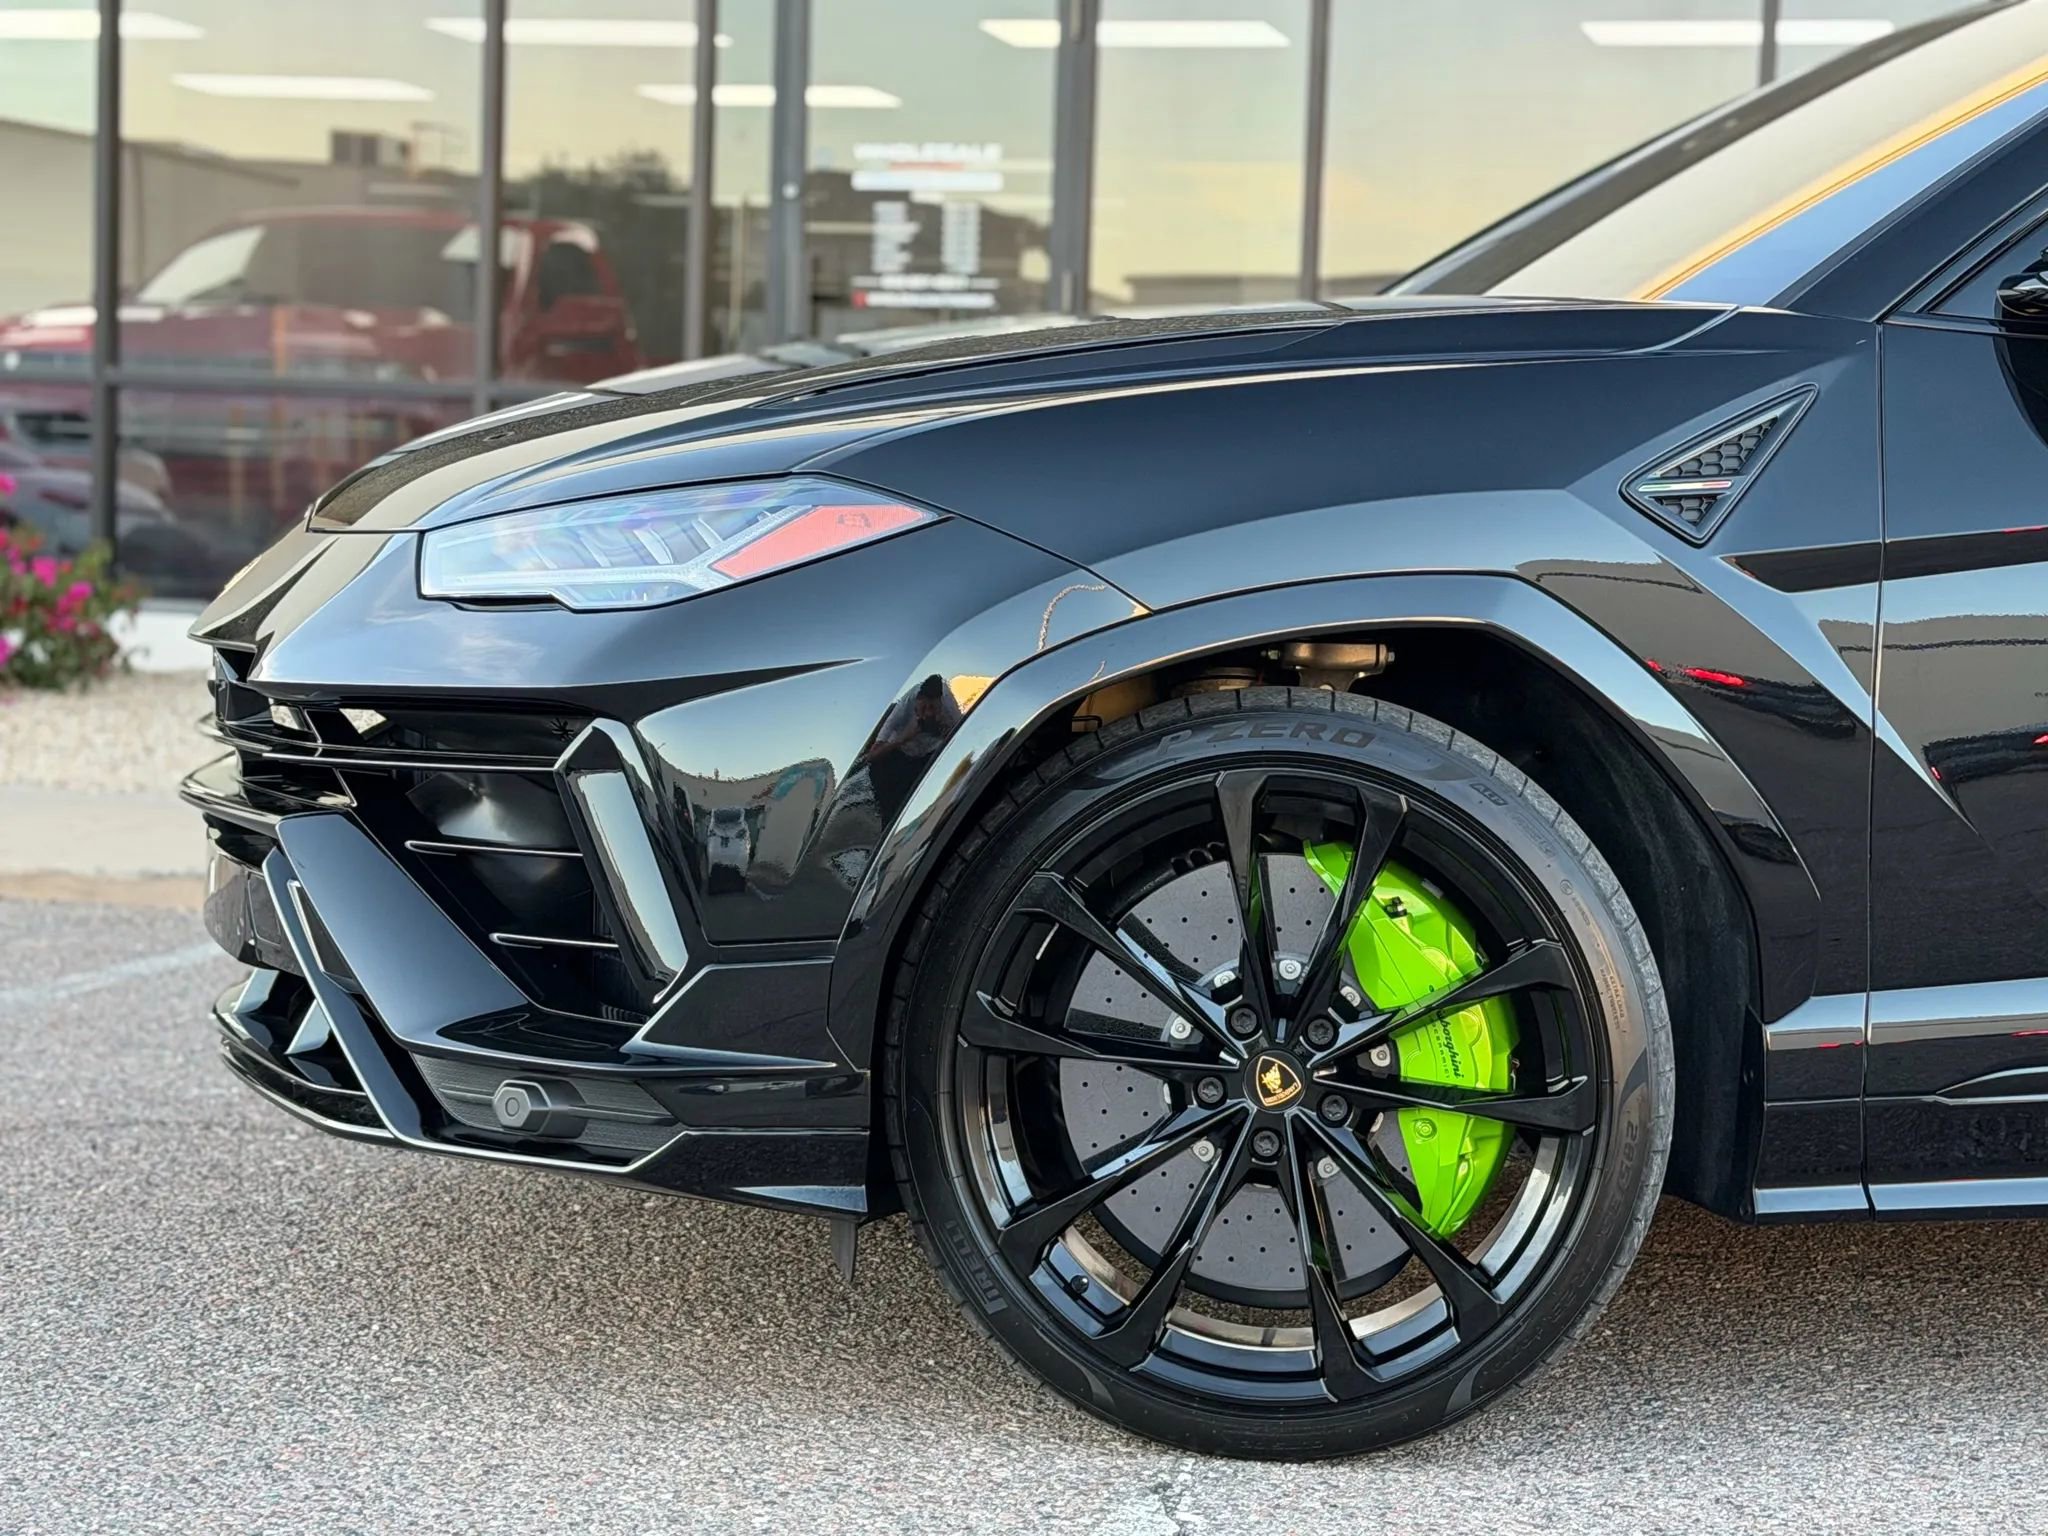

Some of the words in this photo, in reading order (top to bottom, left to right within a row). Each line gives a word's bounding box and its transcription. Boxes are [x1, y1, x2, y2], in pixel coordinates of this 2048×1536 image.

[1156, 728, 1193, 754] P
[1205, 720, 1377, 749] ZERO
[945, 1220, 1008, 1314] PIRELLI
